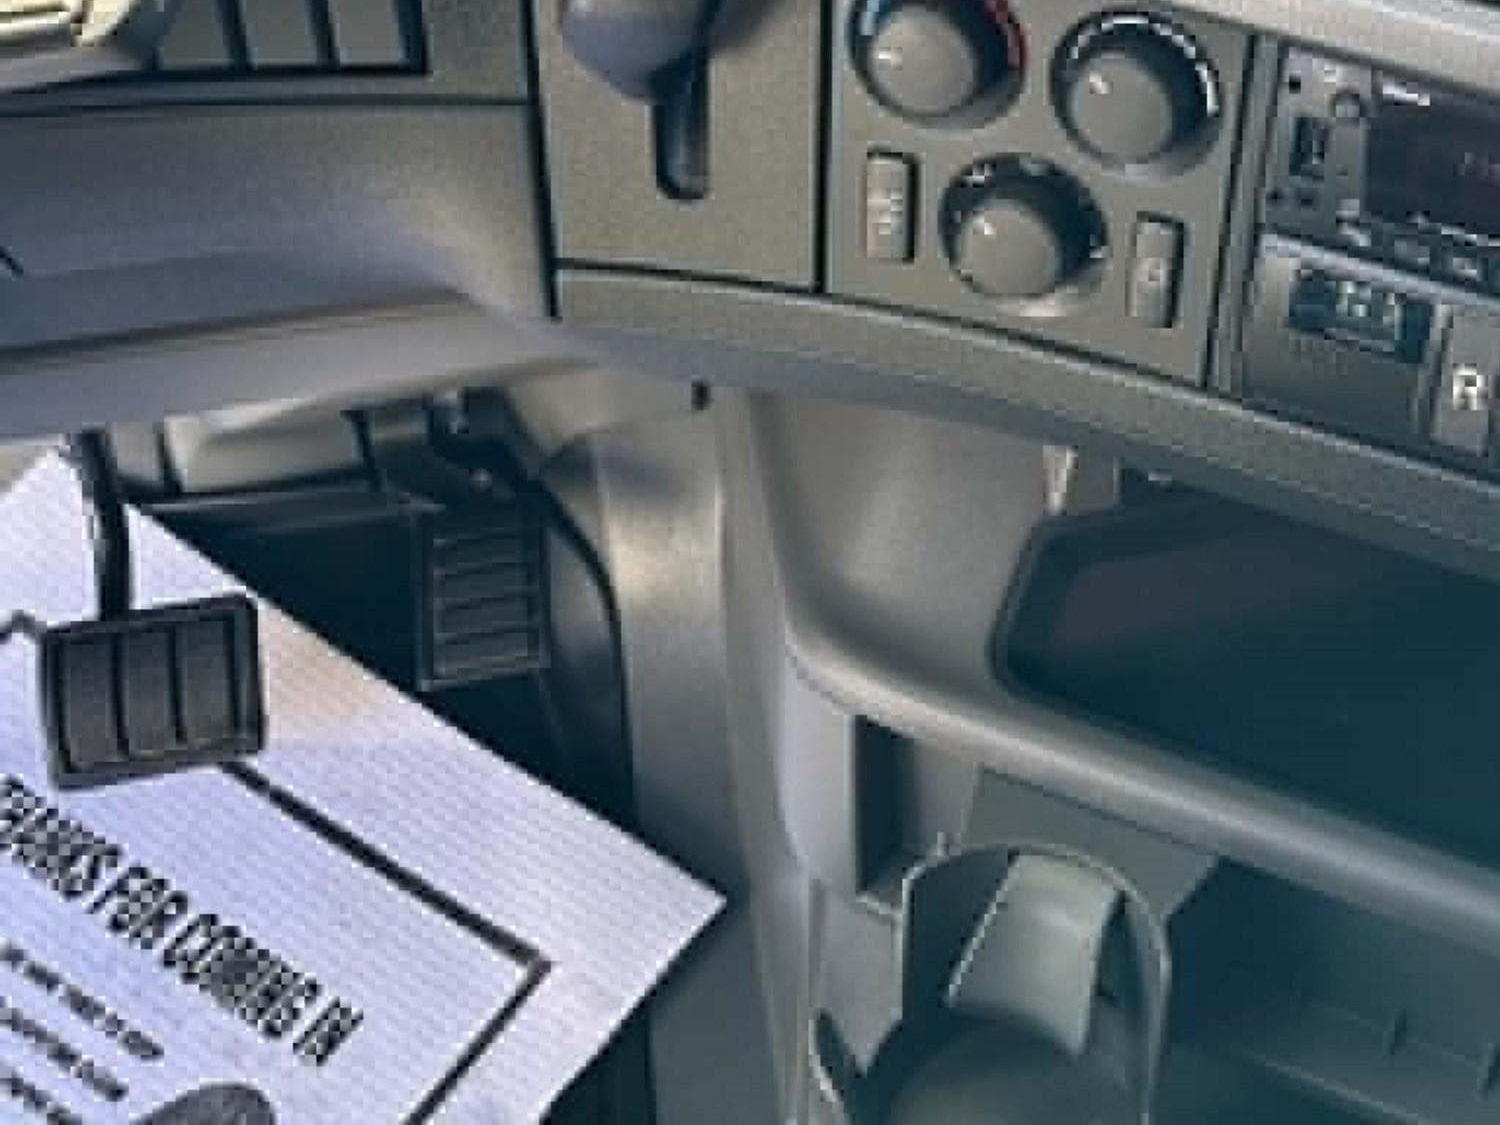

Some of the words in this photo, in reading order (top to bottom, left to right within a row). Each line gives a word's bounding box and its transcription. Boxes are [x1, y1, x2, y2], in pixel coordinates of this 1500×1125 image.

[1452, 364, 1488, 413] R
[84, 865, 190, 951] FOR
[161, 912, 324, 1040] COMING
[291, 995, 366, 1068] IN
